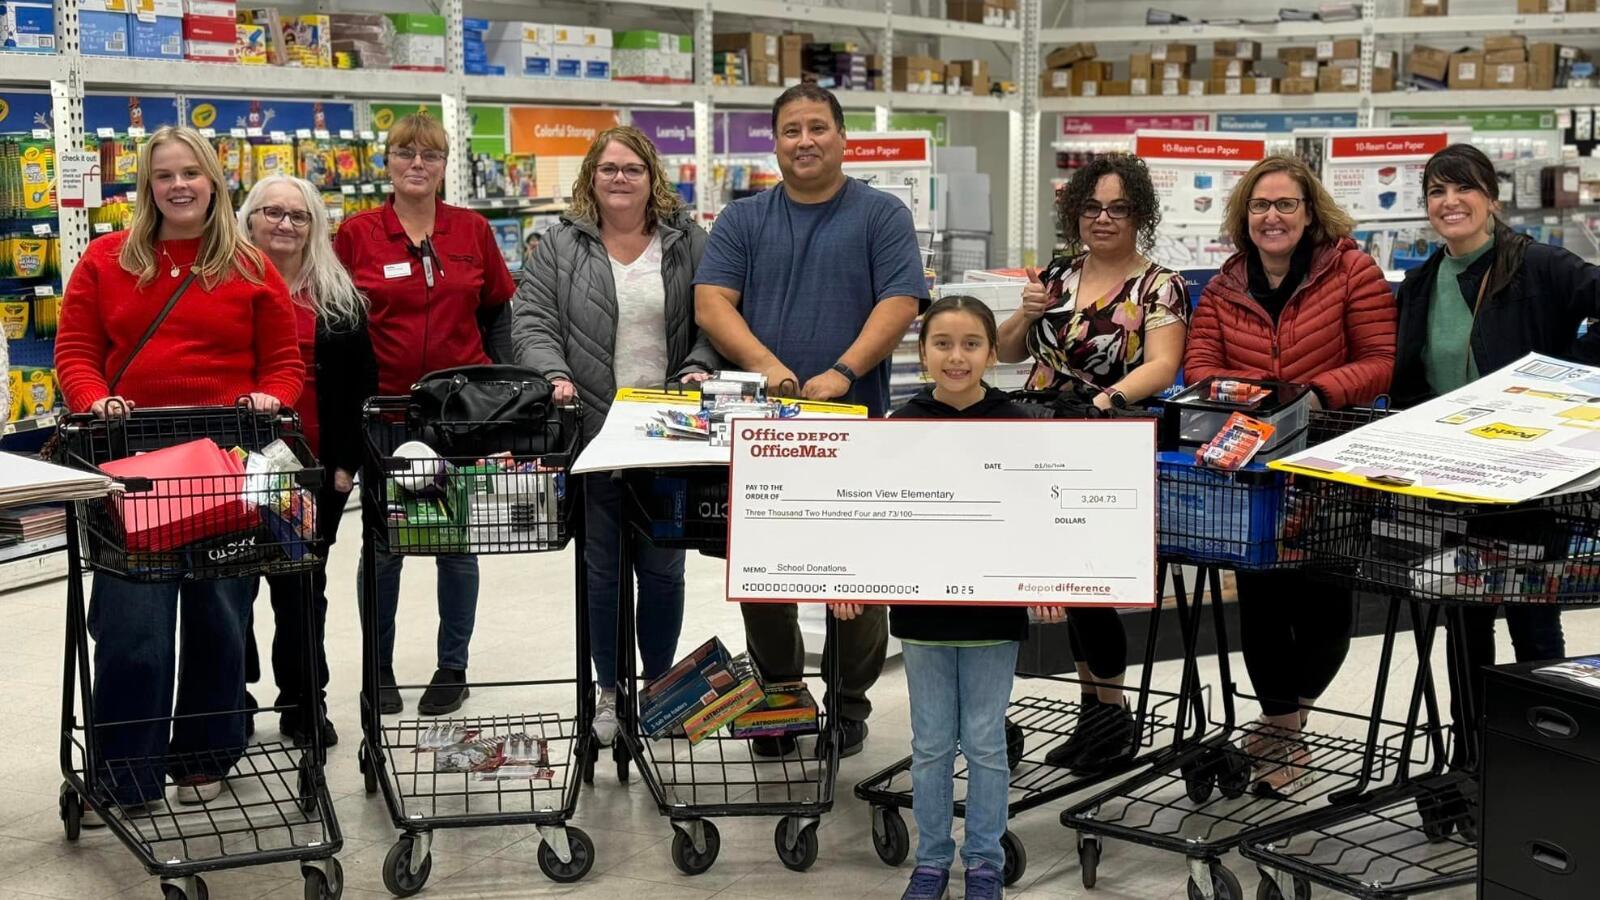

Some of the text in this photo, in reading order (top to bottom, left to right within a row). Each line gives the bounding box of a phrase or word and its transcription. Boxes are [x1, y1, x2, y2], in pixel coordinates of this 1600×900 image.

[534, 124, 596, 139] Colorful Storage
[656, 126, 685, 140] Learning
[748, 126, 773, 140] Learning
[855, 147, 875, 156] Case
[876, 146, 900, 158] Paper
[1162, 144, 1239, 156] 10-Ream Case Paper
[1355, 141, 1424, 152] 10-Ream Case Paper
[741, 428, 850, 442] Office DEPOT
[750, 444, 838, 458] OfficeMax
[836, 489, 954, 500] Mission View Elementary
[1050, 484, 1116, 504] $ 3,204.73
[777, 564, 805, 572] School
[807, 564, 847, 572] Donations
[1018, 583, 1111, 594] #depotdifference
